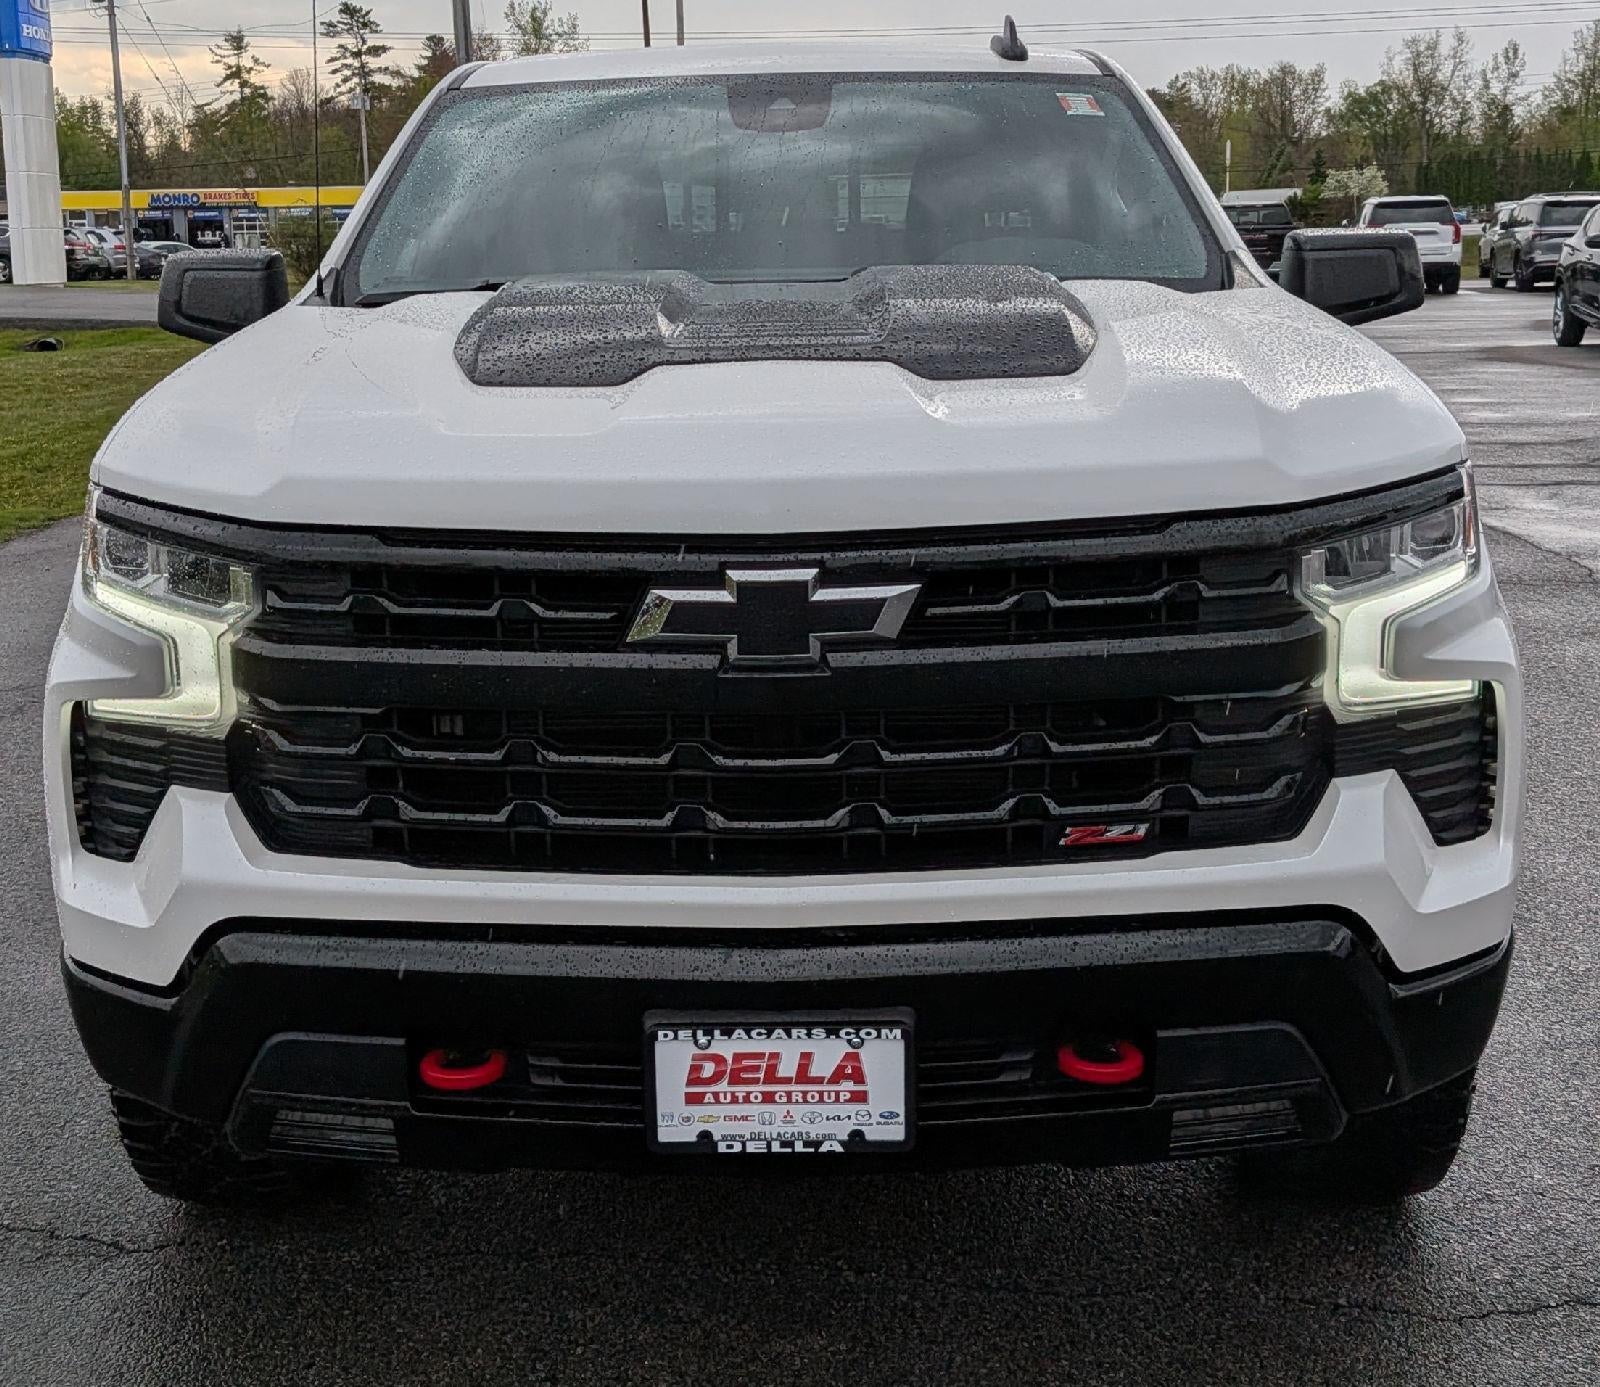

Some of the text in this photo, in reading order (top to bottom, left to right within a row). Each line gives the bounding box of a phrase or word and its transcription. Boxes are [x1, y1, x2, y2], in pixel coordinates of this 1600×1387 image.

[150, 192, 200, 206] MONRO
[657, 1028, 902, 1041] DELLACARS.COM
[685, 1051, 868, 1087] DELLA
[703, 1091, 851, 1103] AUTO GROUP
[723, 1114, 756, 1122] GMC
[720, 1131, 837, 1140] www.DELLACARS.com
[717, 1140, 845, 1153] DELLA
